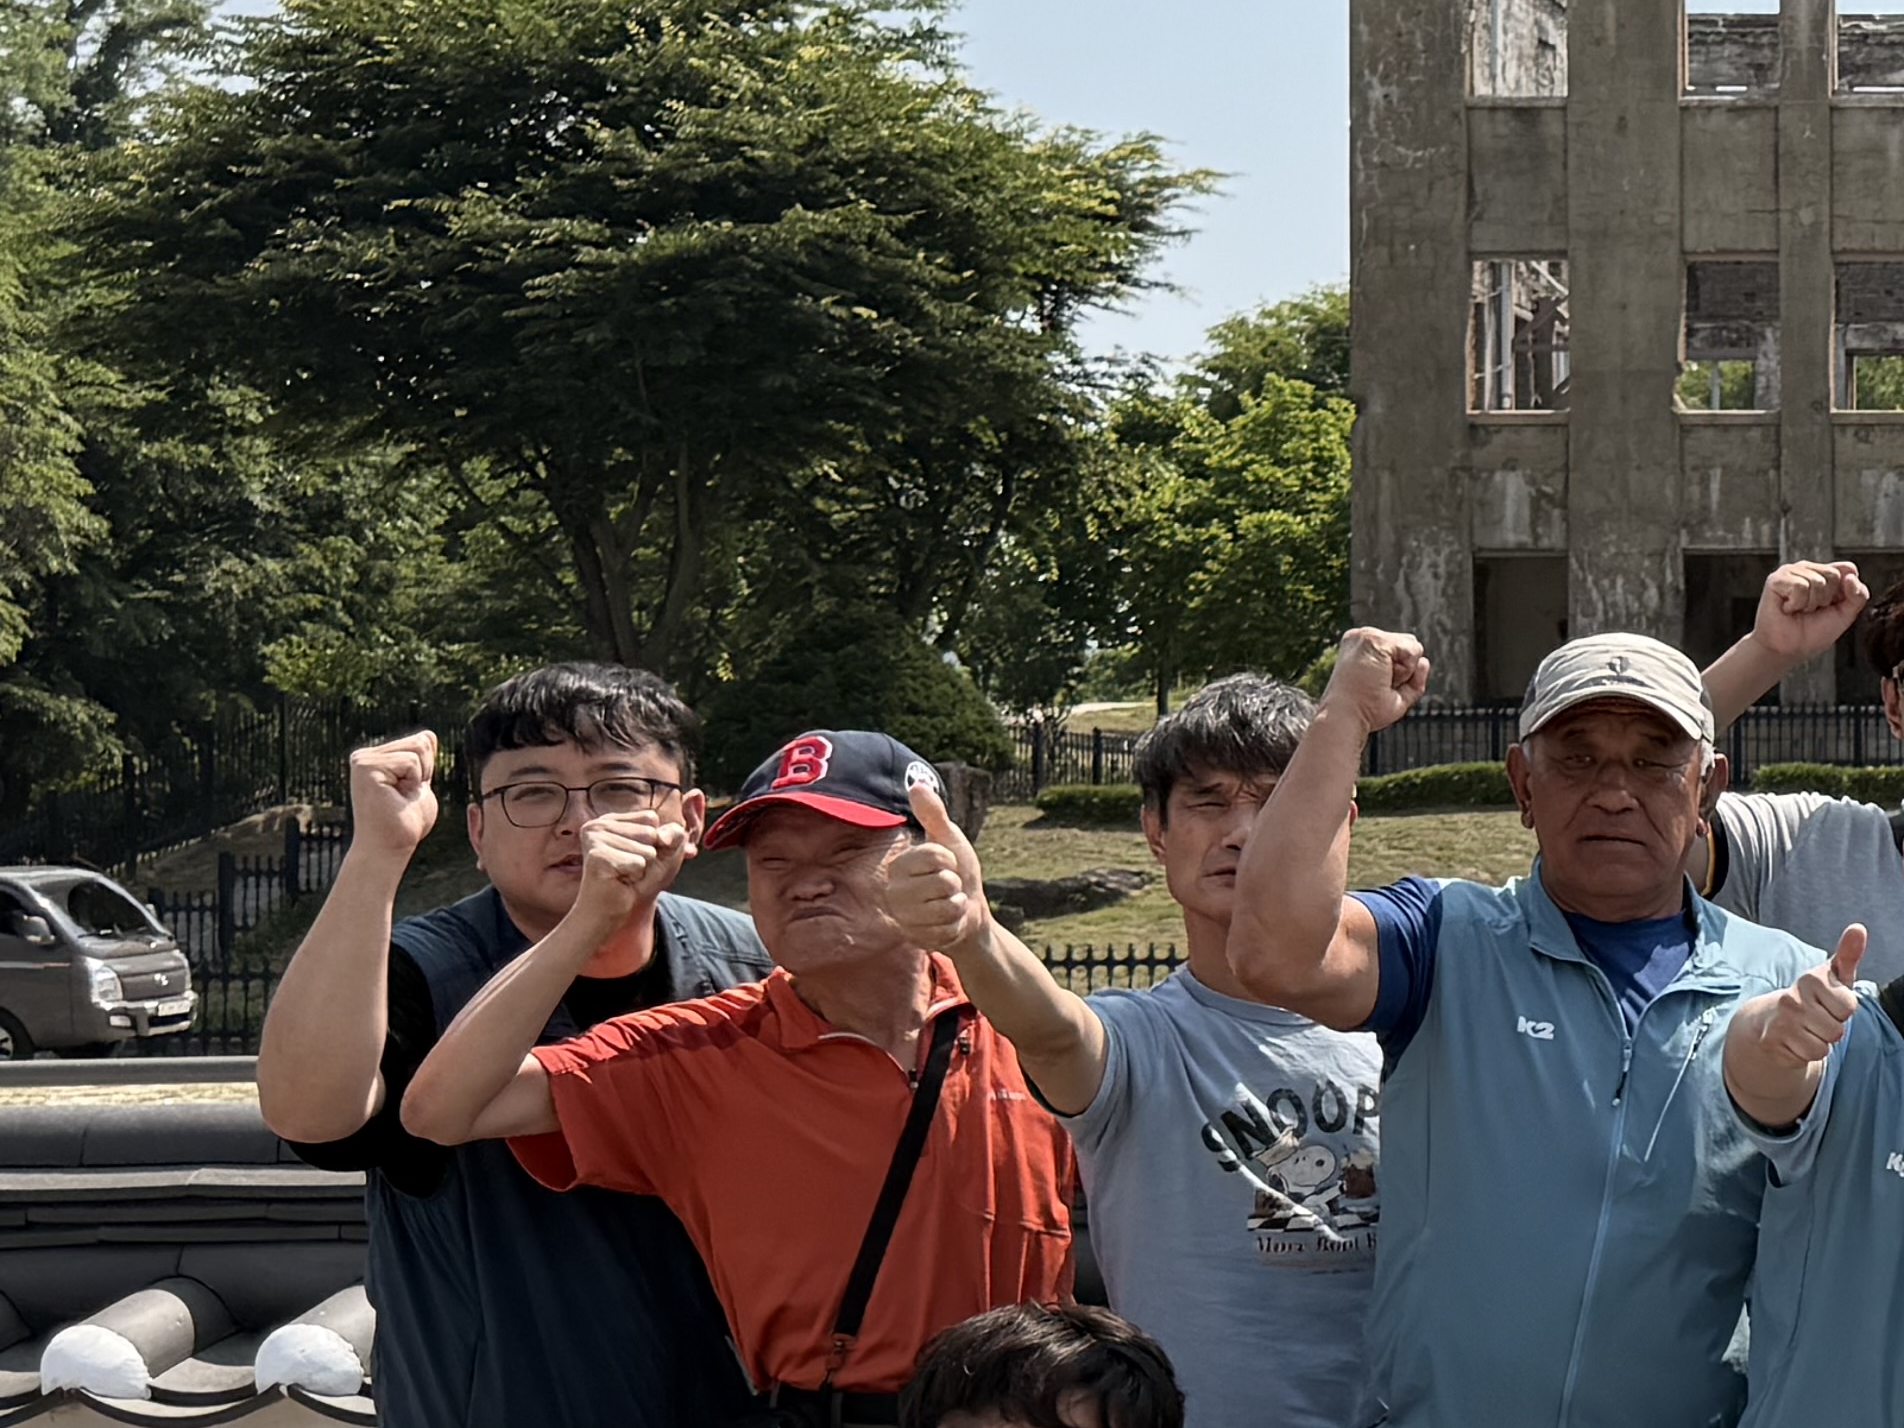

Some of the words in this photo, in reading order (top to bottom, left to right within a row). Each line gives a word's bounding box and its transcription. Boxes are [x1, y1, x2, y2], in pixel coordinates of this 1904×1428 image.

[770, 735, 833, 789] B
[1517, 1015, 1555, 1040] K2
[1201, 1080, 1380, 1173] SNOOP
